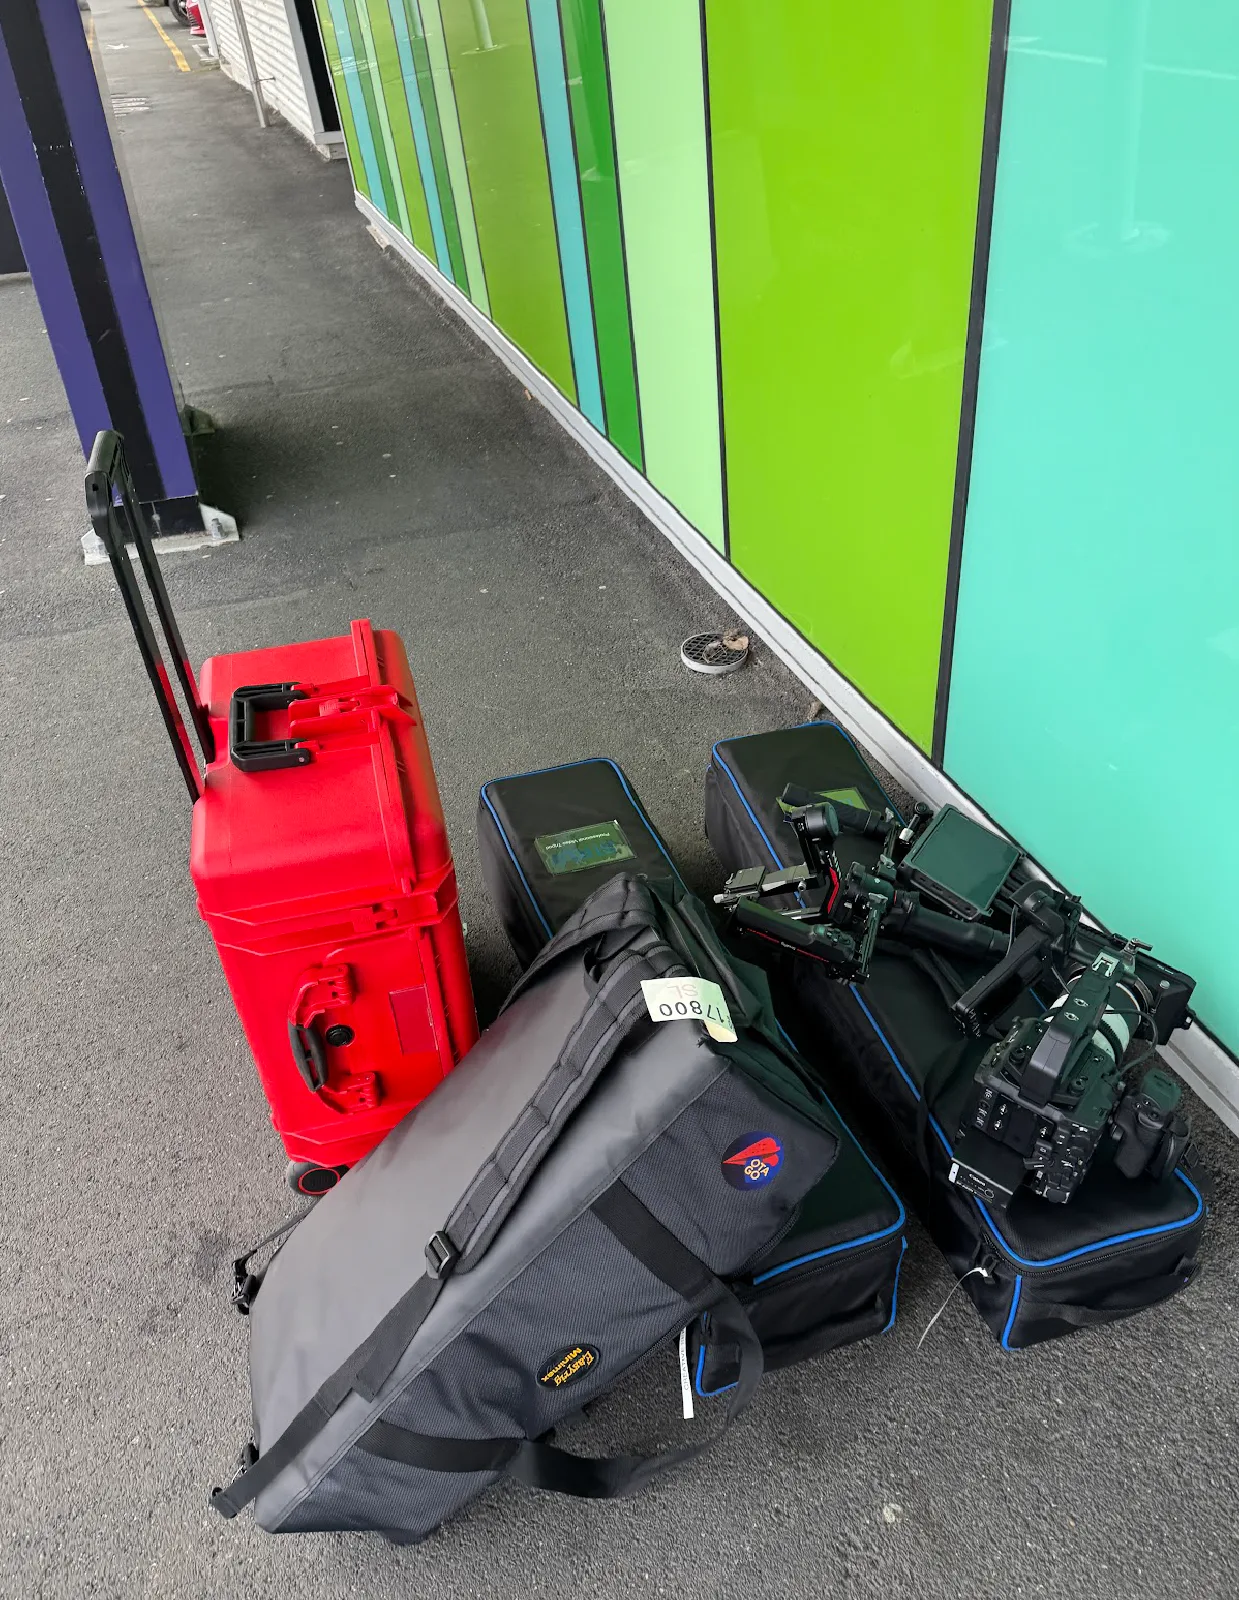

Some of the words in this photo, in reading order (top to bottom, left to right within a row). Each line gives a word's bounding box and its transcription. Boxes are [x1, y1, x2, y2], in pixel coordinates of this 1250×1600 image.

[659, 1000, 725, 1024] 17800
[541, 1347, 582, 1382] Minimax
[554, 1350, 594, 1387] Easyrig
